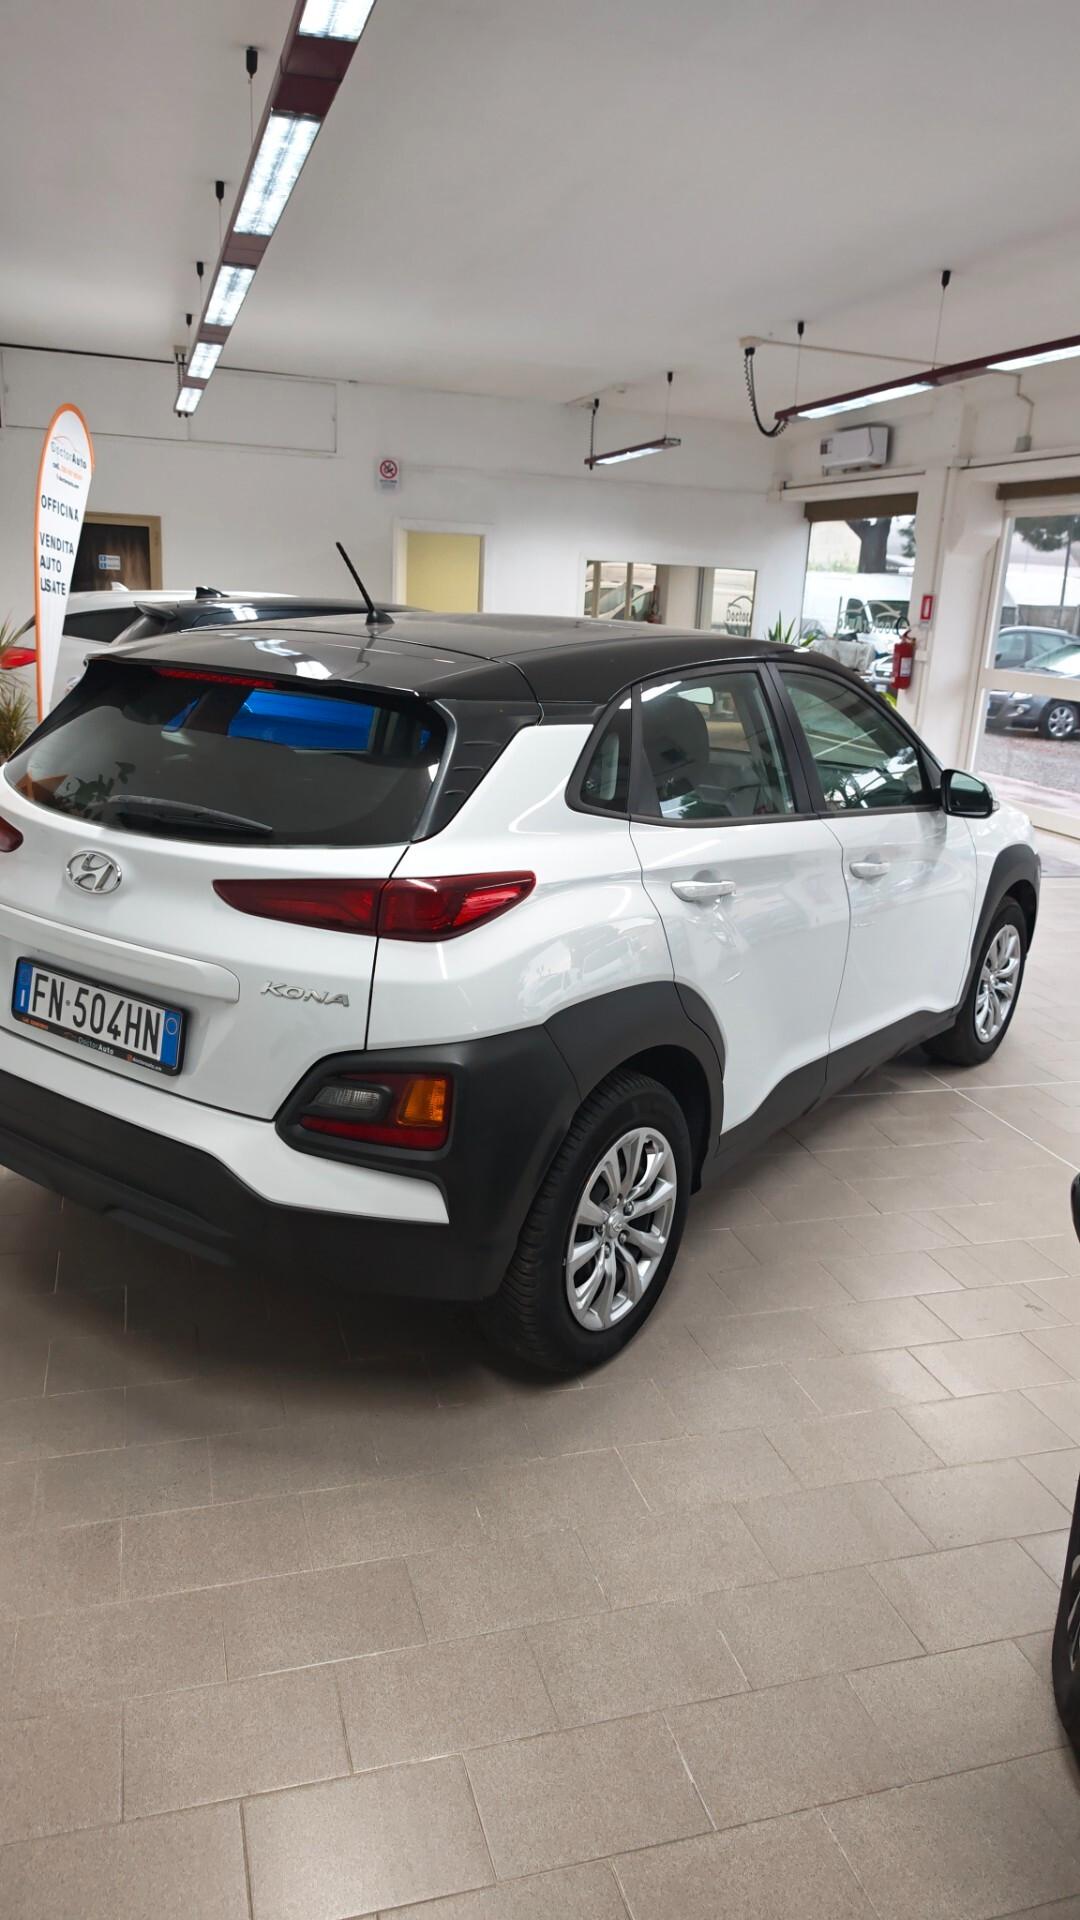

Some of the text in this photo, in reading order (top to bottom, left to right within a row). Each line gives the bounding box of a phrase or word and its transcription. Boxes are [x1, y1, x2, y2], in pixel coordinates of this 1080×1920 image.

[41, 494, 79, 521] OFFICINA
[40, 532, 74, 556] VENDITA
[40, 555, 62, 573] AUTO
[41, 577, 66, 596] USATE
[260, 981, 349, 1008] KONA
